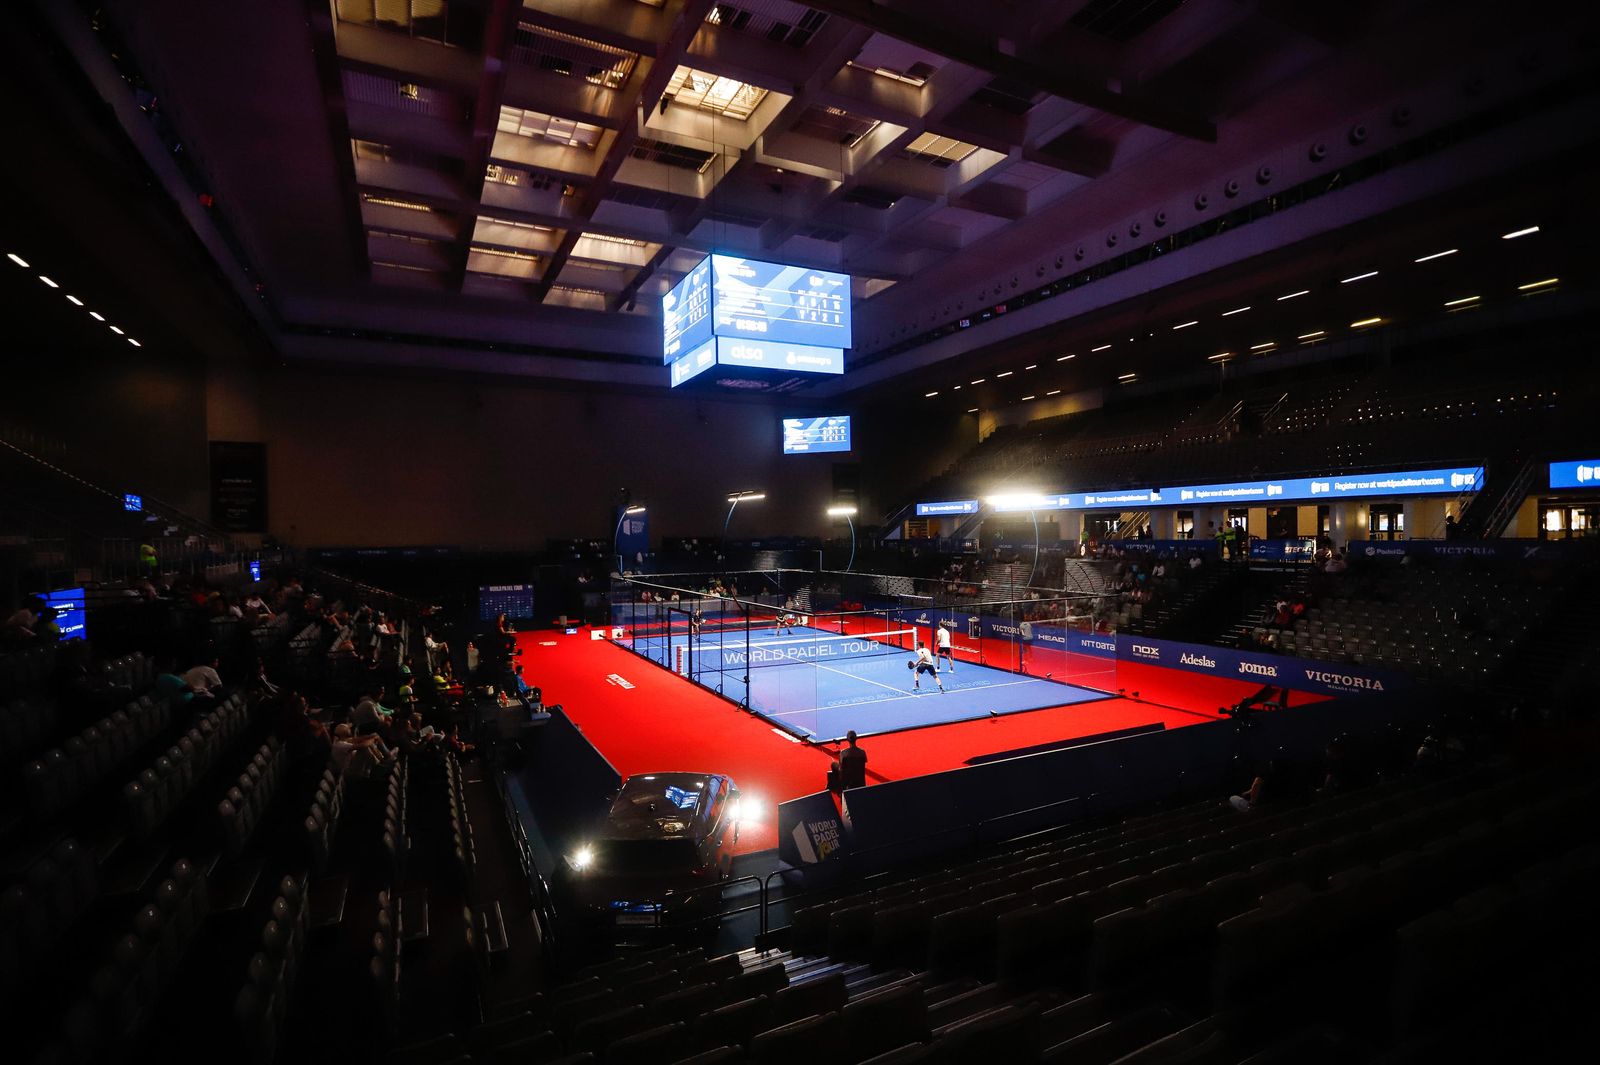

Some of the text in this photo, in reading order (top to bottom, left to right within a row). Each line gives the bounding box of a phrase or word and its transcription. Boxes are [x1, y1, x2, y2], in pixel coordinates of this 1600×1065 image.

[1334, 481, 1357, 491] Register
[1037, 634, 1066, 644] HEAD
[724, 640, 880, 665] WORLD PADEL TOUR
[1180, 652, 1216, 668] Adeslas
[1305, 670, 1385, 691] VICTORIA
[808, 819, 838, 834] WORLD
[812, 829, 840, 846] PADEL
